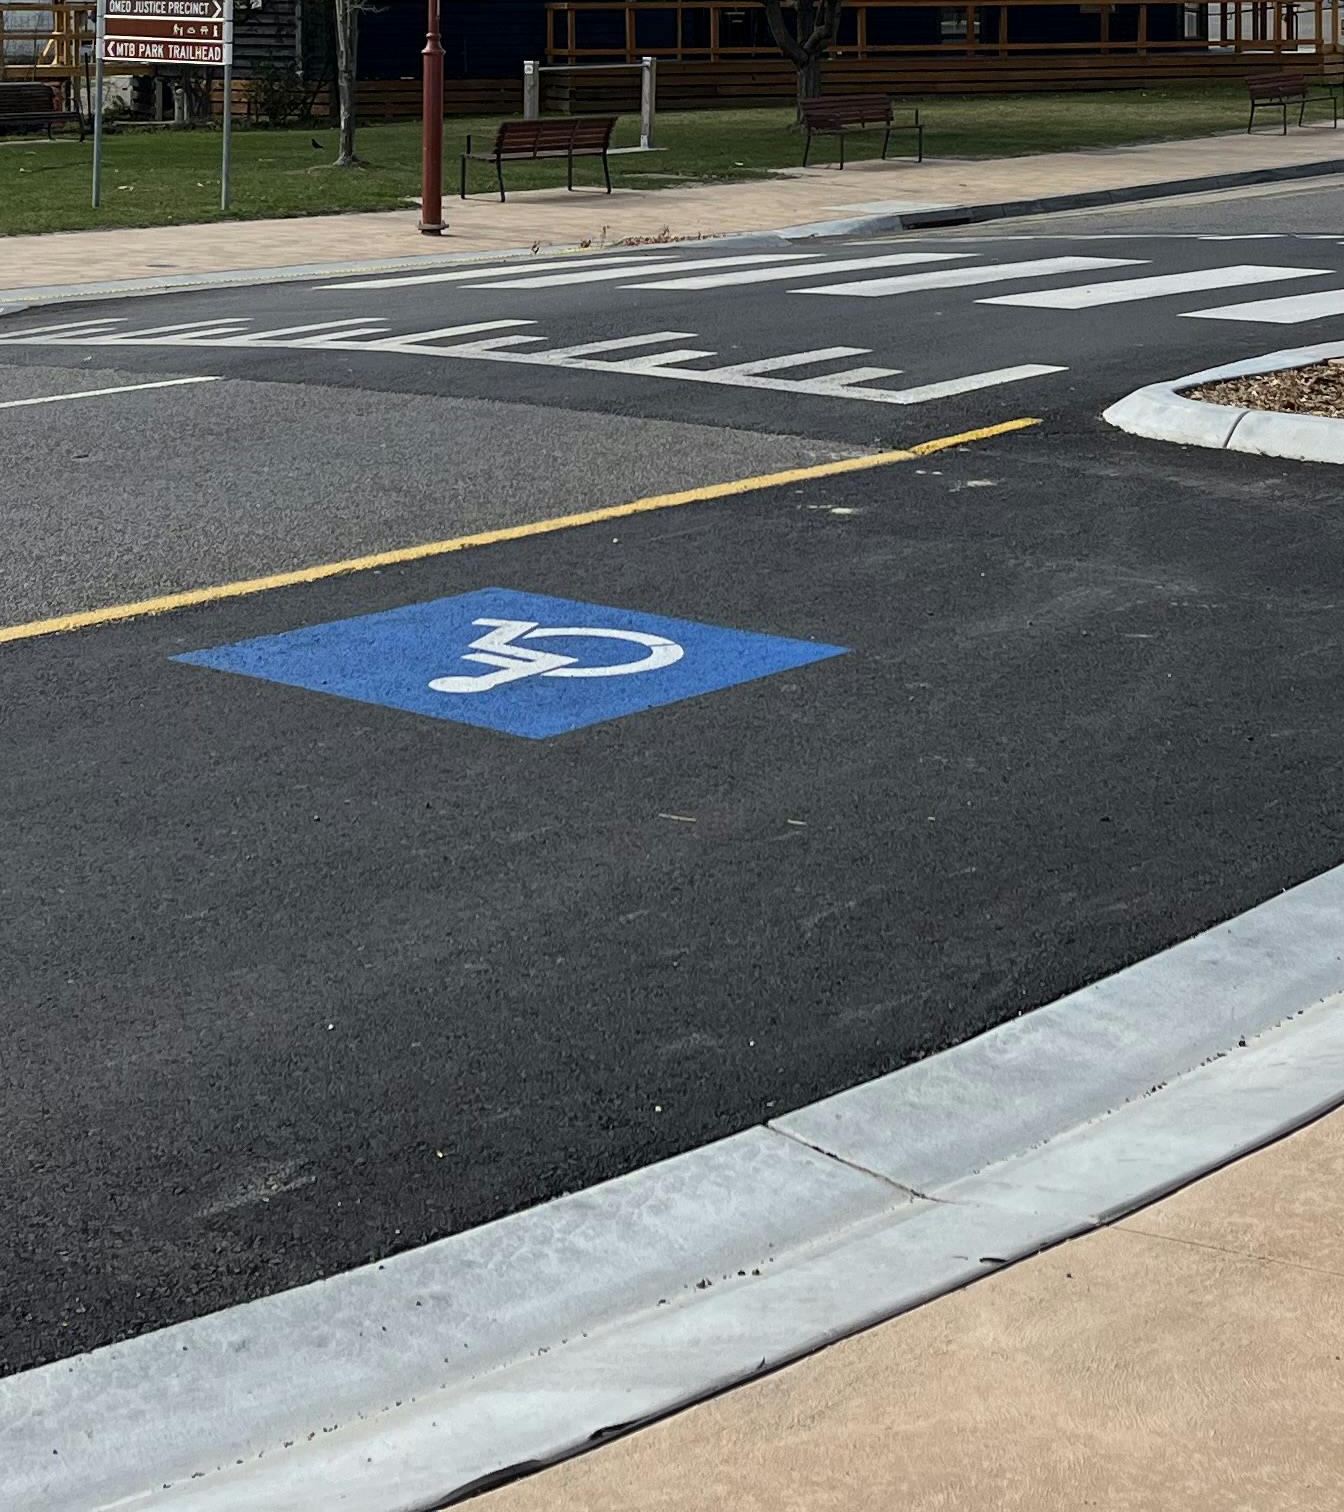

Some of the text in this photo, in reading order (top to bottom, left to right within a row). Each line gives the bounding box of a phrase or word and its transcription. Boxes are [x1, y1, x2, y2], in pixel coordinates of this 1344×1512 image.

[109, 0, 210, 16] OMEO JUSTICE PRECINCT
[116, 42, 221, 61] MTB PARK TRAILHEAD
